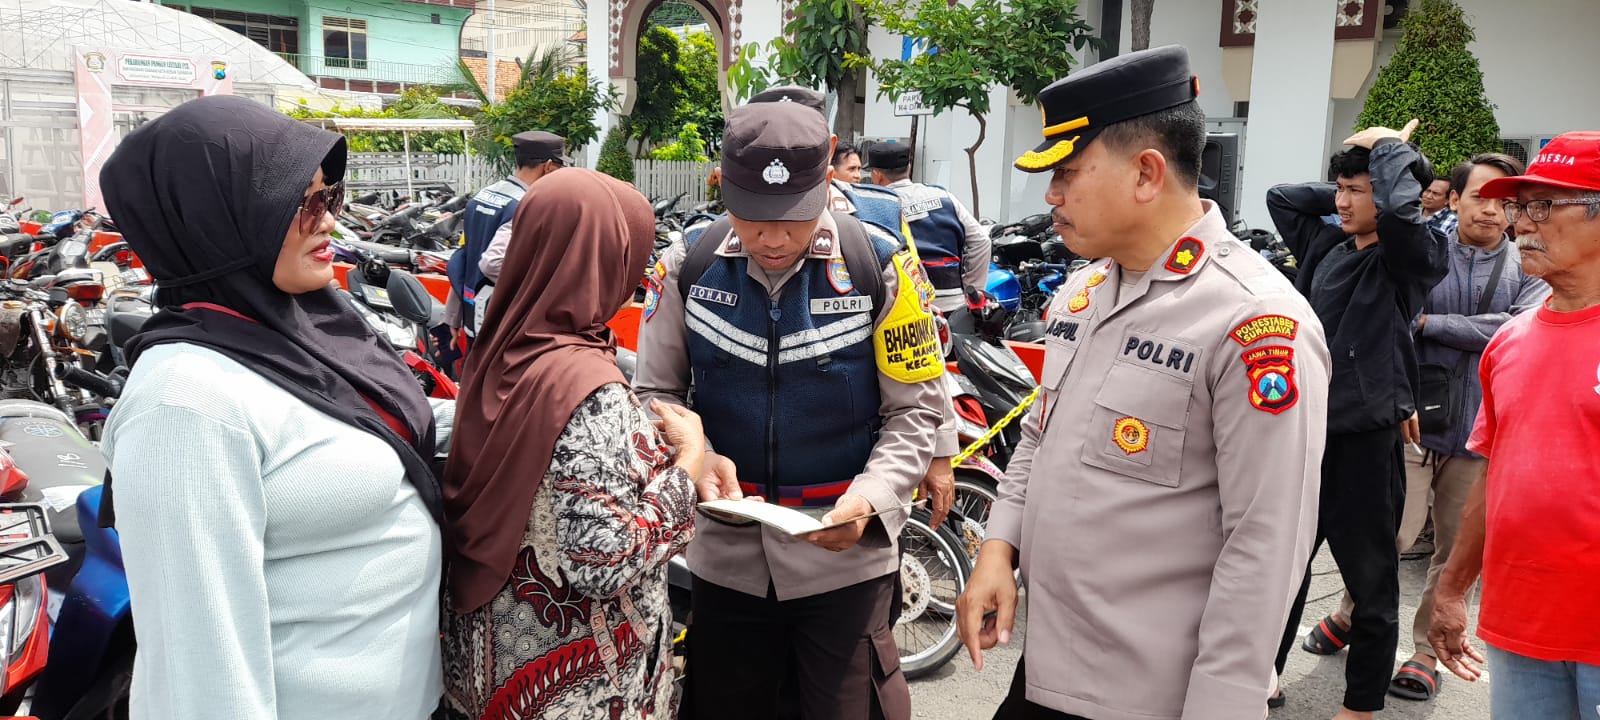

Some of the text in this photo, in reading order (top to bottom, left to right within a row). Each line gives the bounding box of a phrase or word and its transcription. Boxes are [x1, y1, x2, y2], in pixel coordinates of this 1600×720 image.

[691, 286, 732, 304] JOHAN
[823, 299, 862, 311] POLRI
[884, 317, 937, 353] BHABINKA
[1235, 316, 1295, 338] POLRESTABES
[1243, 325, 1291, 342] SURABAYA
[887, 352, 909, 365] KEL.
[1123, 336, 1195, 373] POLRI
[1248, 350, 1267, 361] JAWA
[905, 358, 931, 371] KEC.
